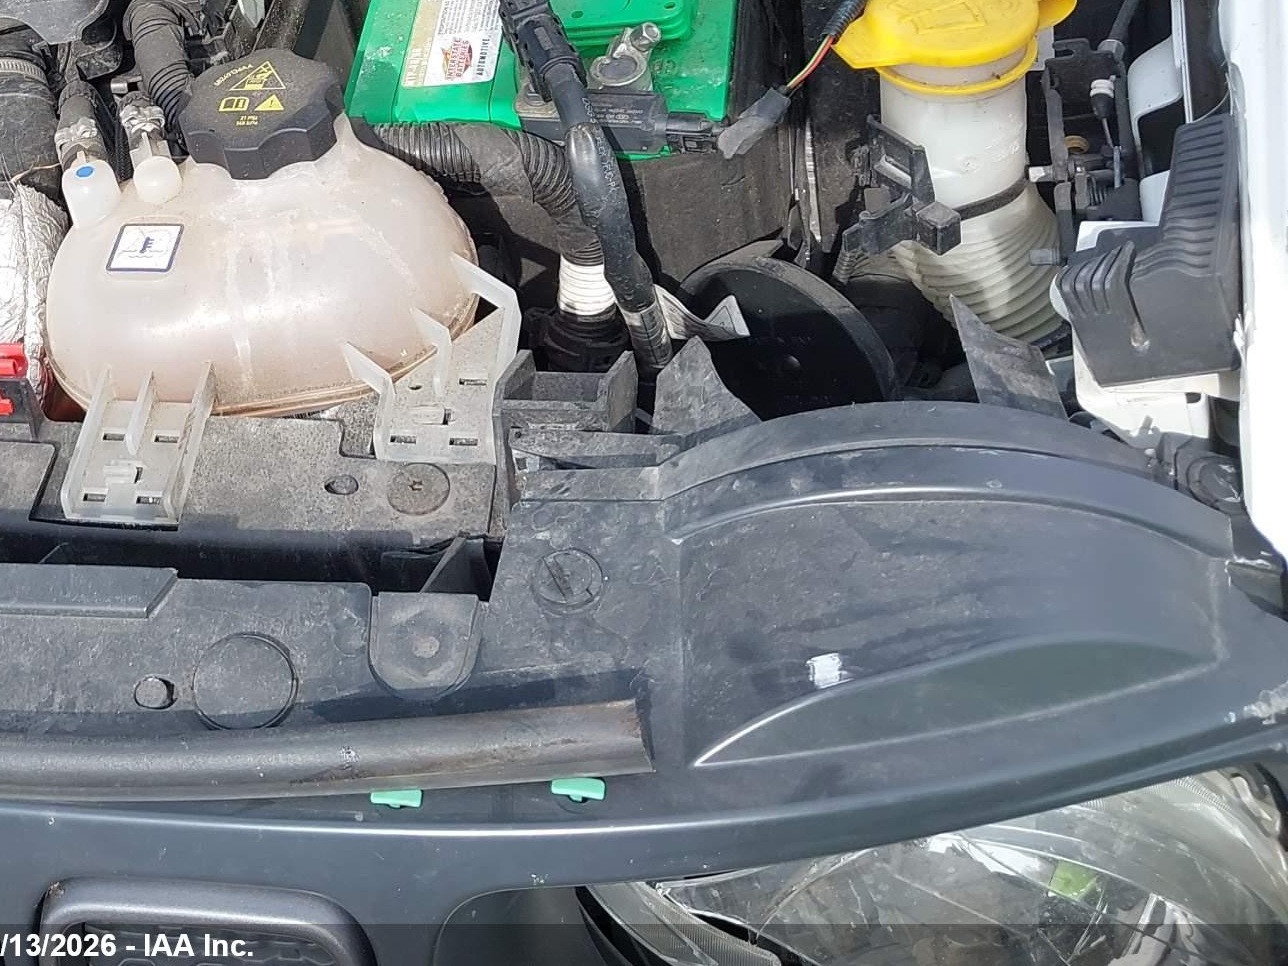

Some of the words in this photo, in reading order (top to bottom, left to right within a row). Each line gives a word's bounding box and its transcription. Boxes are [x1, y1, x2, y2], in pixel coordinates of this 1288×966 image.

[446, 37, 462, 81] INTERSTATE
[455, 40, 470, 78] BATTERIES
[475, 38, 491, 77] AUTOMOTIVE
